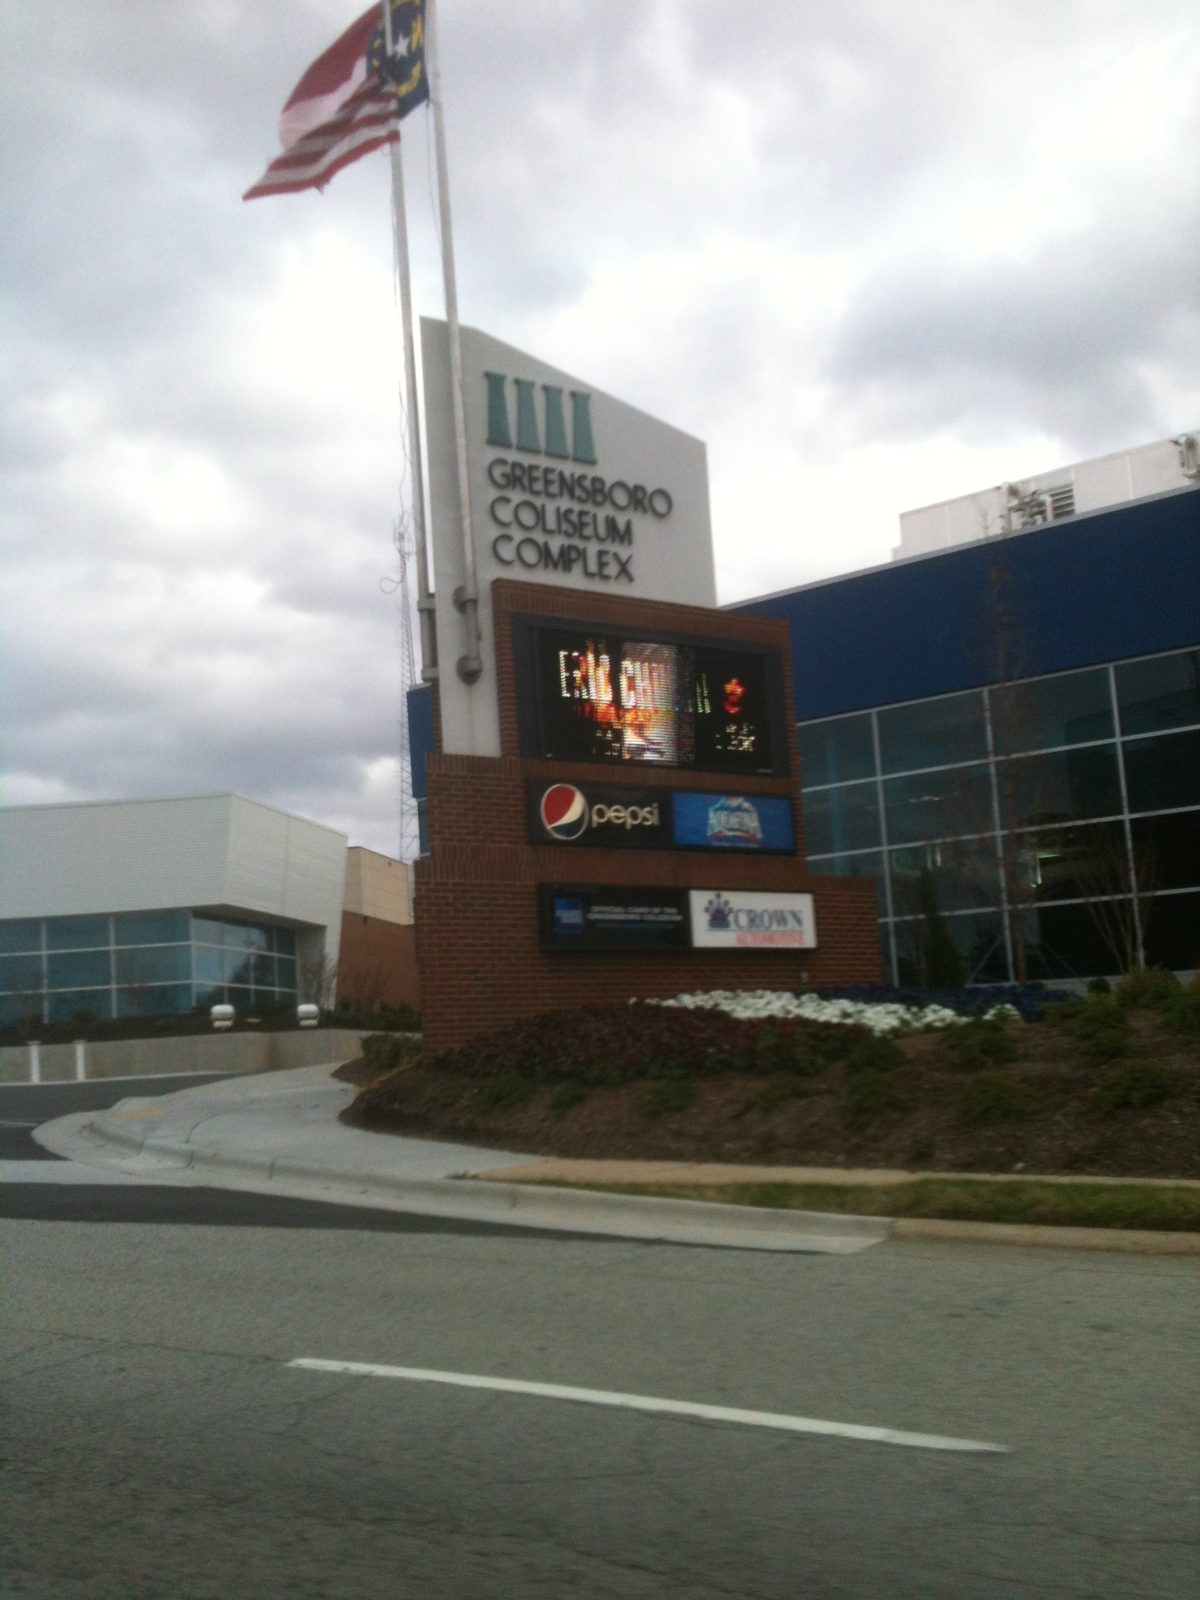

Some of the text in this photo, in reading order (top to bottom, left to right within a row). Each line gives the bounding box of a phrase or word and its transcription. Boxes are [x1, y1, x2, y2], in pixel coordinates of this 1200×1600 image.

[487, 457, 673, 518] GREENSBORO
[490, 496, 633, 545] COLISEUM
[492, 534, 634, 582] COMPLEX
[592, 803, 659, 829] pepsi
[734, 909, 803, 929] CROWN
